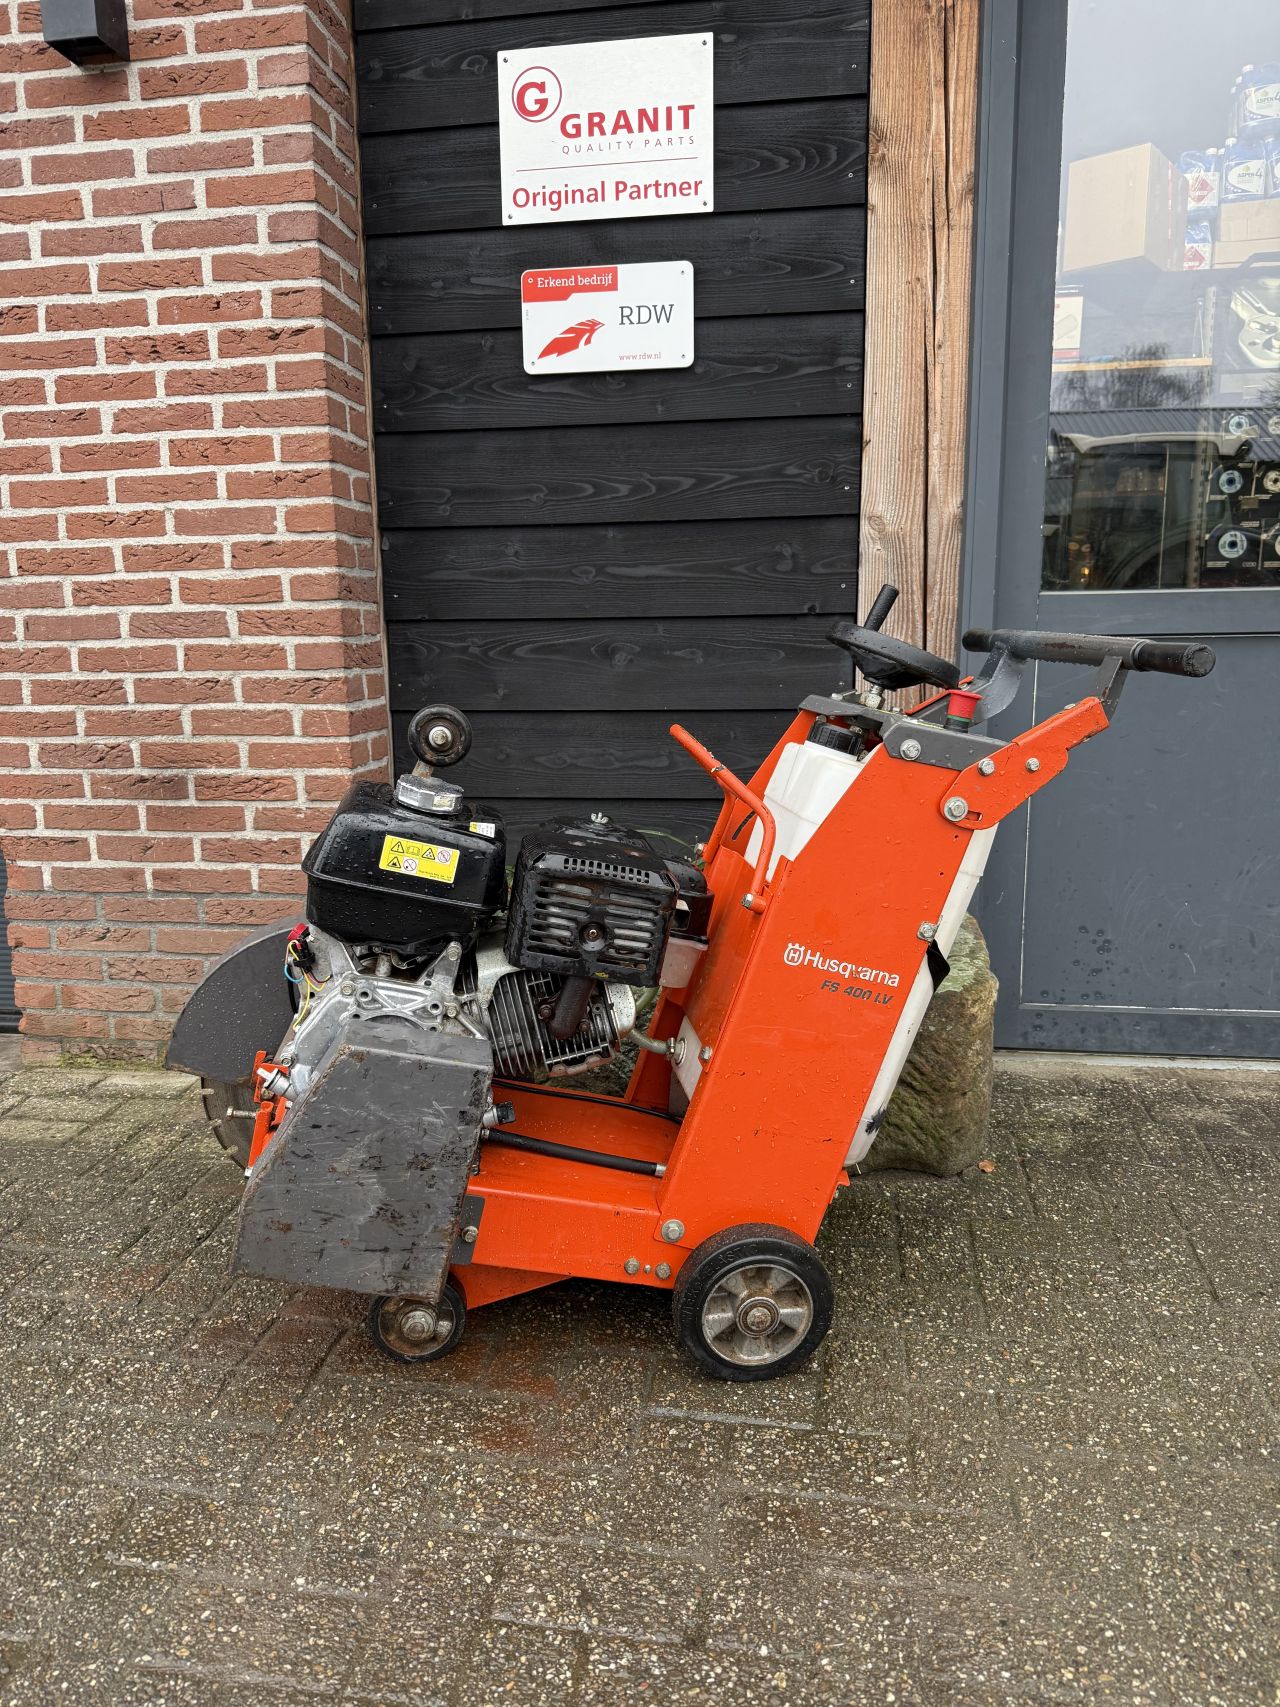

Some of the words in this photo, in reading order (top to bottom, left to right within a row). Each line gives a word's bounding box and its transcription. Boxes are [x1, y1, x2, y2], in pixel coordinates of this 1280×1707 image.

[516, 81, 549, 118] G
[559, 104, 695, 139] GRANIT
[562, 140, 634, 155] QUALITY
[644, 135, 695, 148] PARTS
[512, 180, 605, 212] Original
[615, 179, 703, 201] Partner
[537, 275, 575, 288] Erkend
[577, 273, 613, 286] bedrijf
[619, 303, 675, 326] RDW
[618, 351, 662, 361] www.rdw.nl
[804, 949, 900, 987] Husqvarna
[821, 979, 840, 993] FS
[843, 985, 873, 1001] 400
